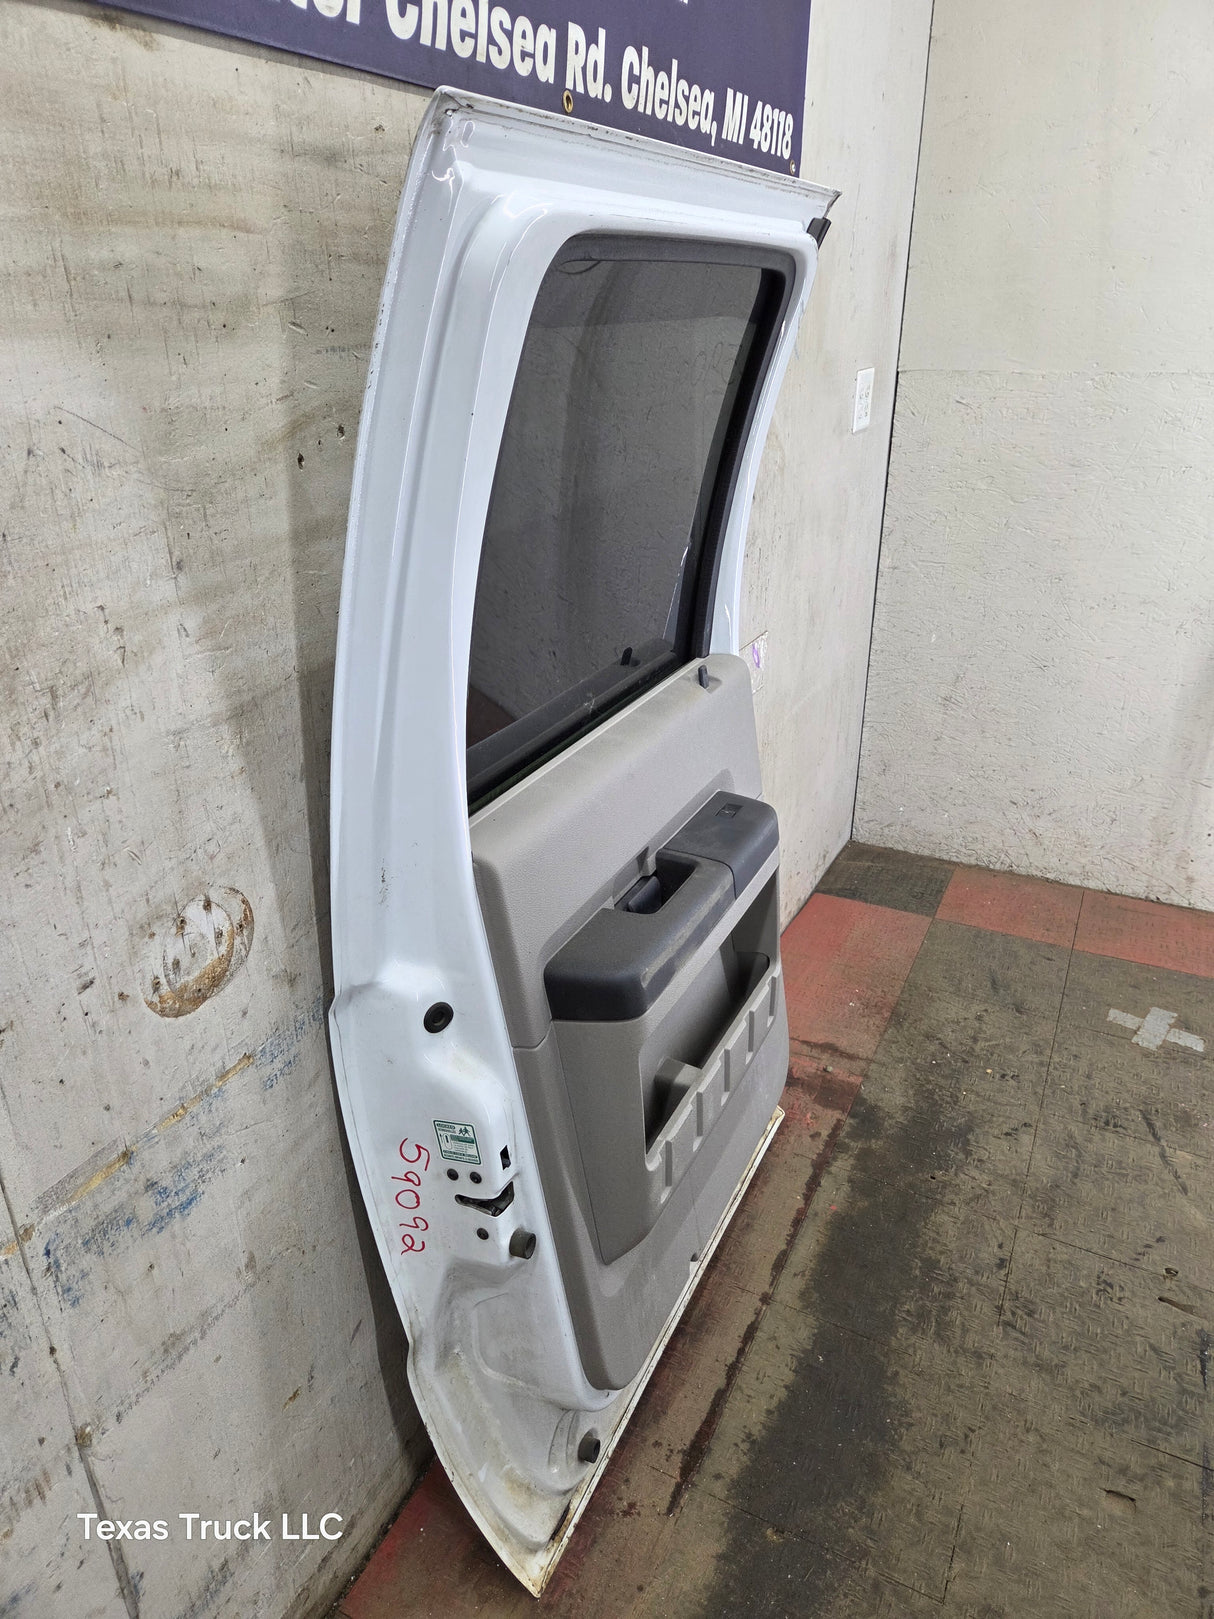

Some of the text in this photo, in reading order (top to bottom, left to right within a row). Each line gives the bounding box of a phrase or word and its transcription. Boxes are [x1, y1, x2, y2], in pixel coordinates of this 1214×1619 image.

[565, 21, 612, 103] Rd.
[621, 45, 717, 146] Chelsea,
[721, 87, 748, 145] MI
[749, 100, 794, 160] 48118
